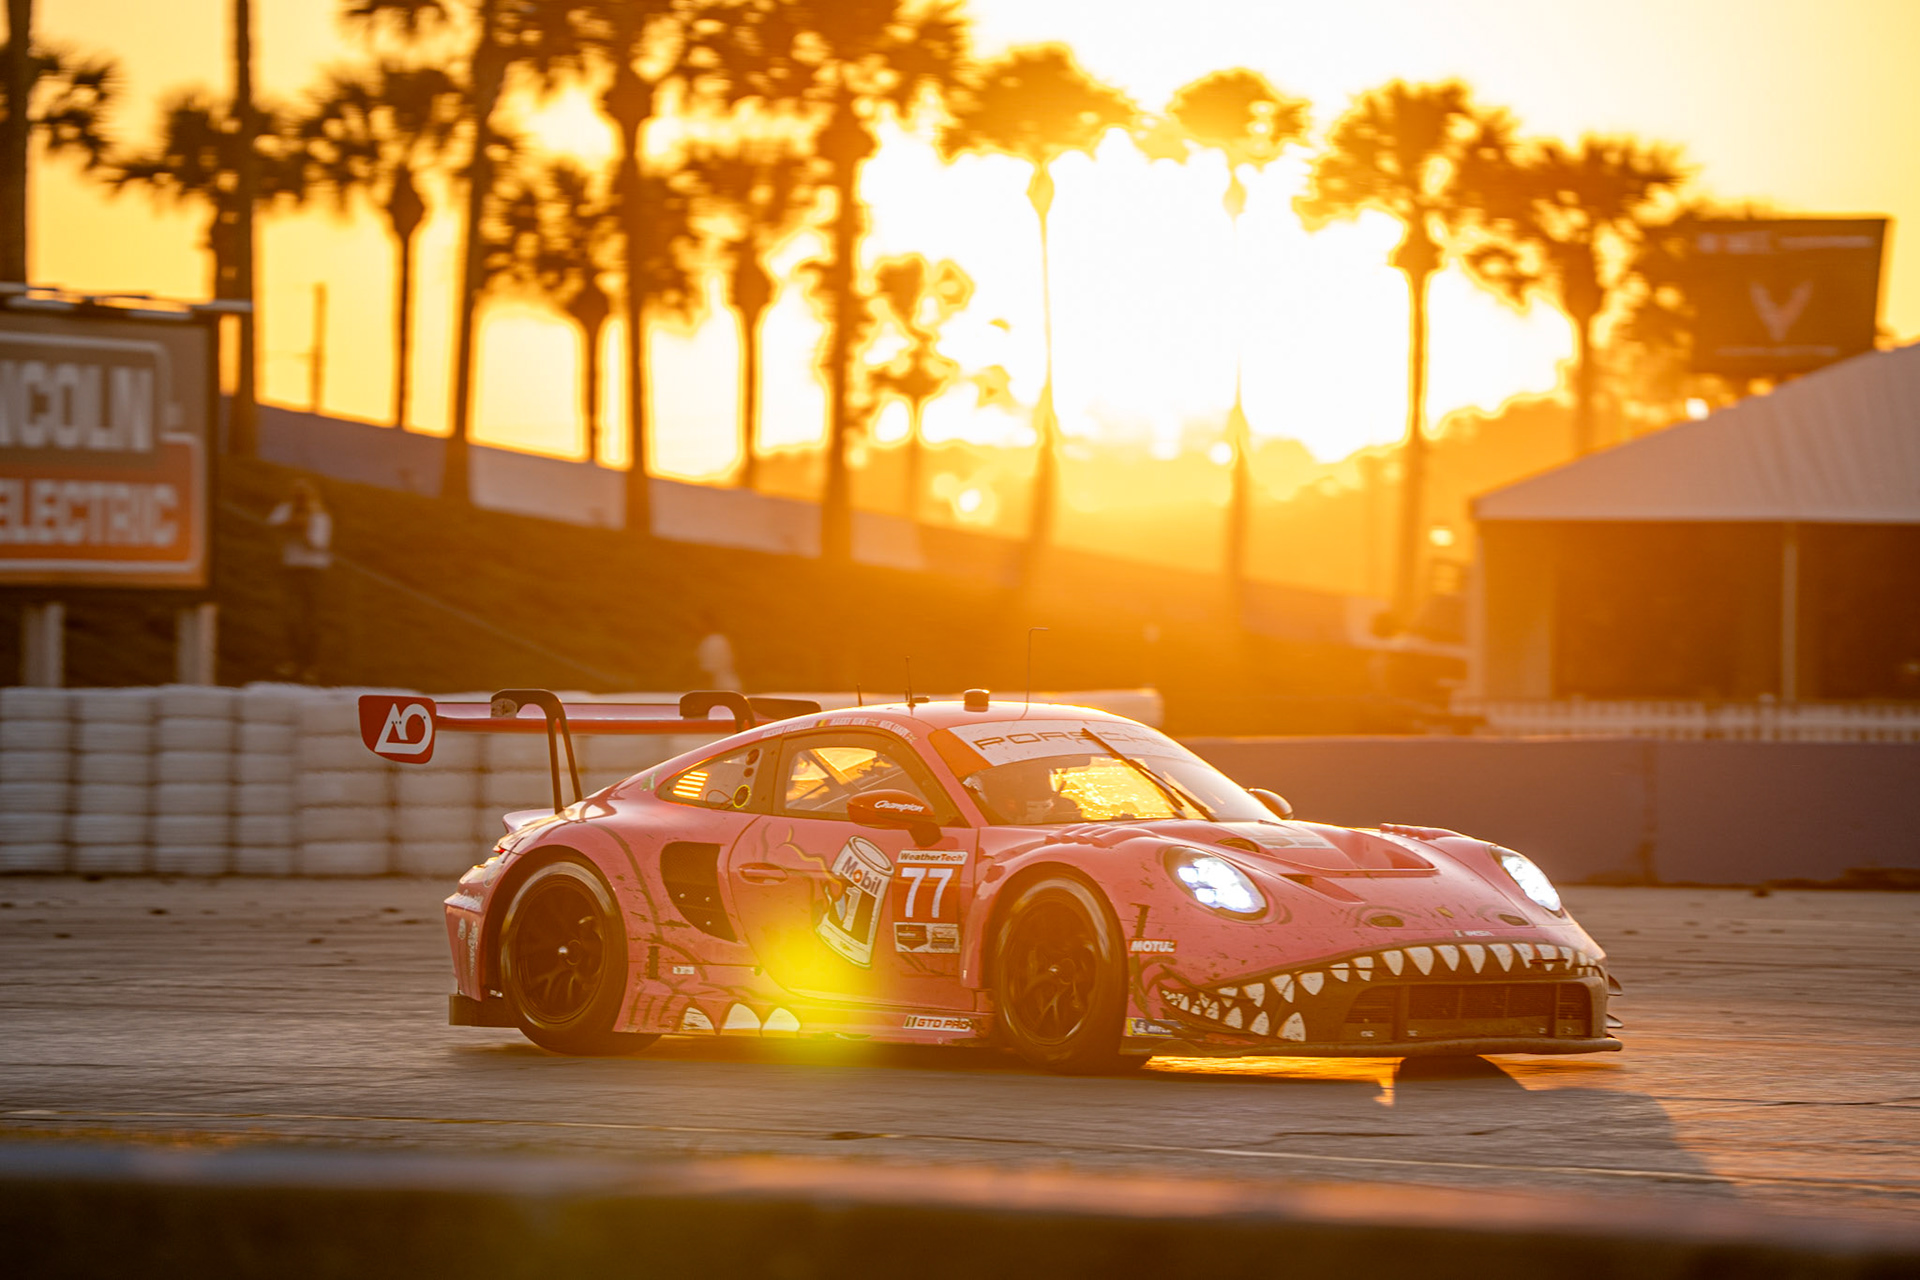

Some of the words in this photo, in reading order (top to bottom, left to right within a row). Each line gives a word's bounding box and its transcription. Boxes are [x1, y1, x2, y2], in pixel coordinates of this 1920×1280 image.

[874, 800, 924, 812] Champion
[900, 852, 964, 861] WeatherTech
[841, 856, 882, 895] Mobil
[901, 867, 954, 918] 77
[842, 885, 862, 932] 1
[1131, 940, 1175, 952] MOTUL
[917, 1018, 942, 1028] GTD
